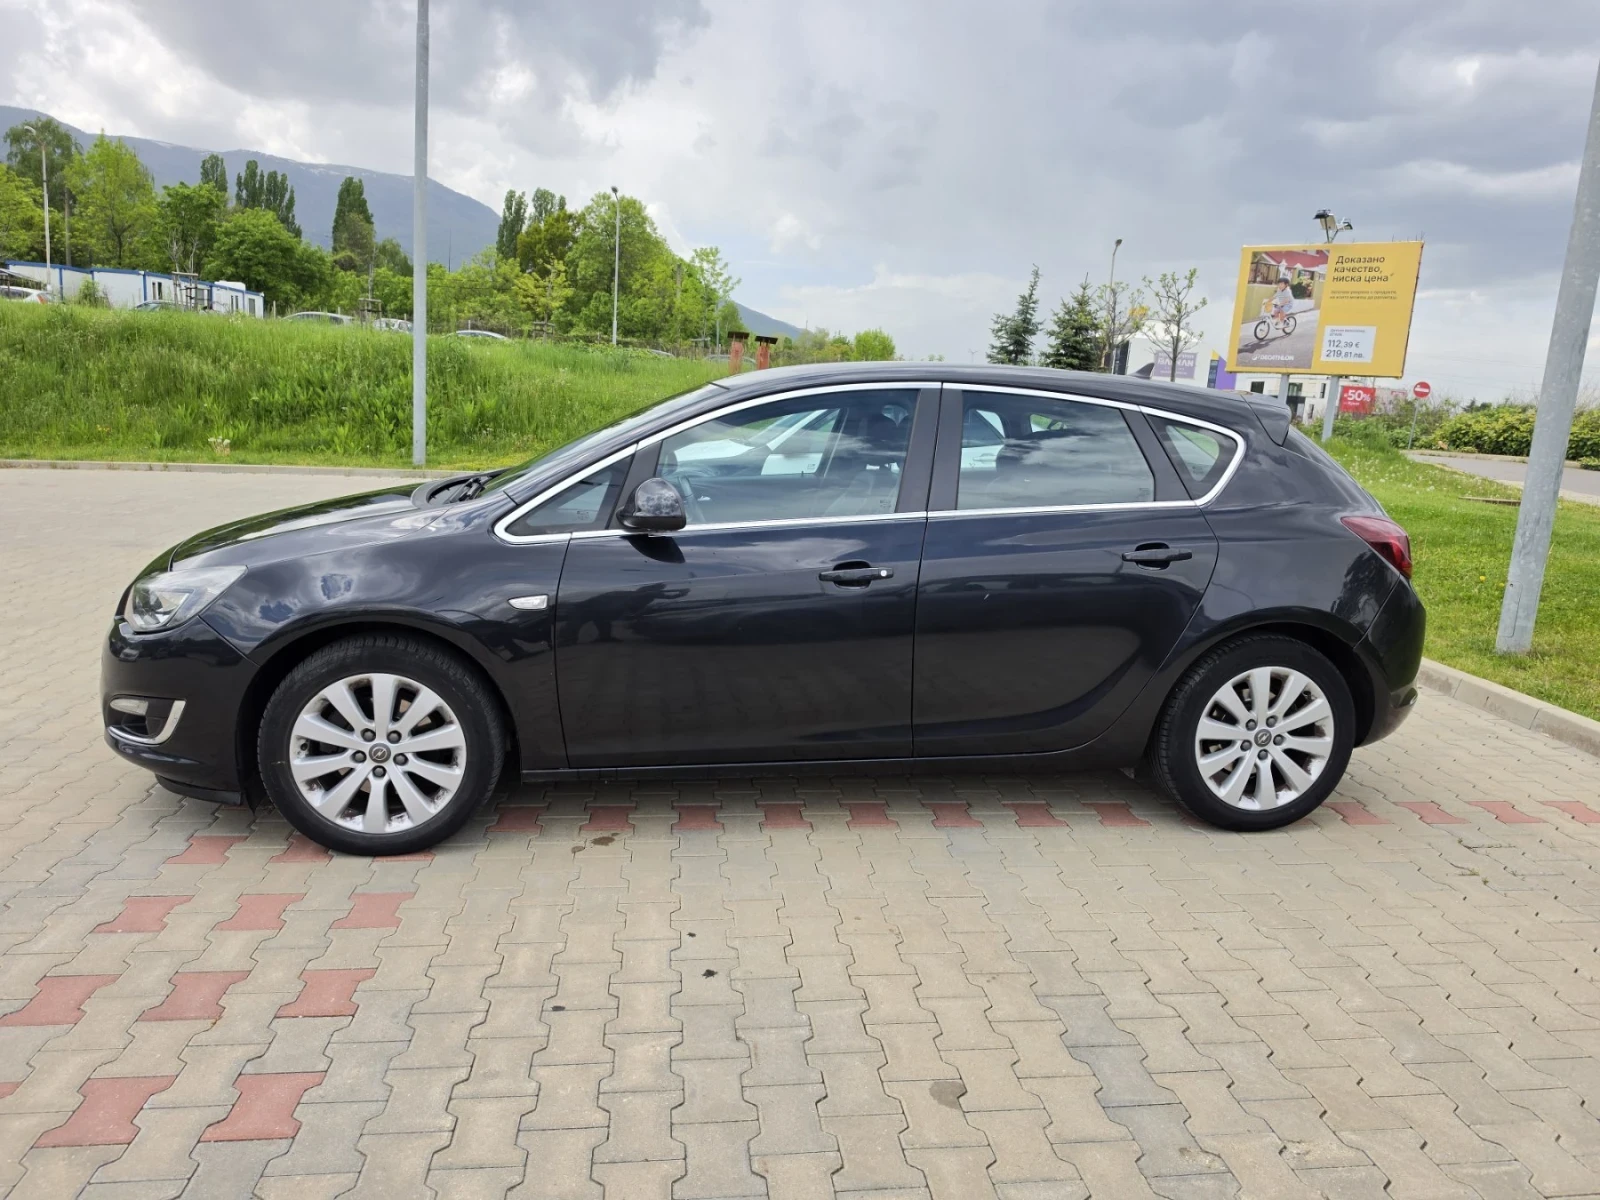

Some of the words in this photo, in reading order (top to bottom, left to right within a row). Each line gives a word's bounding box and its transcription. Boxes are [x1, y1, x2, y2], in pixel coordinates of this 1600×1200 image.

[1335, 255, 1386, 265] Доказано
[1333, 266, 1383, 274] качество,
[1332, 275, 1362, 283] ниска
[1364, 275, 1389, 283] цена
[1327, 340, 1354, 348] 112,39
[1344, 389, 1371, 402] -50%
